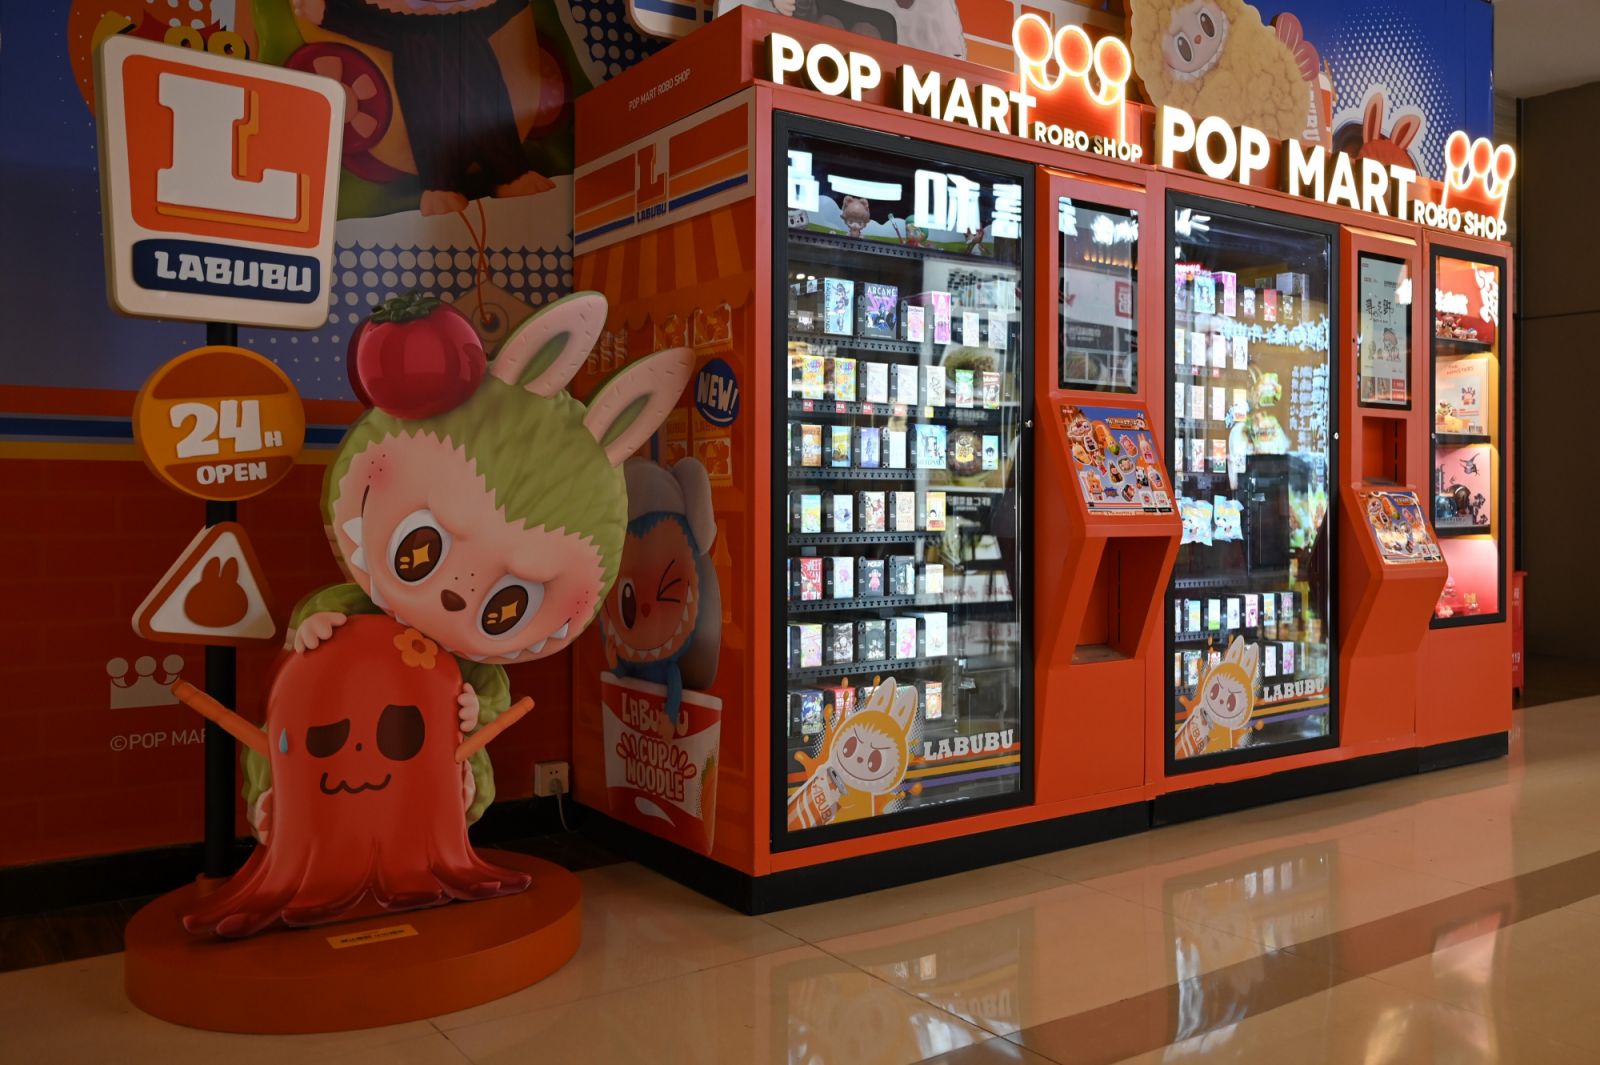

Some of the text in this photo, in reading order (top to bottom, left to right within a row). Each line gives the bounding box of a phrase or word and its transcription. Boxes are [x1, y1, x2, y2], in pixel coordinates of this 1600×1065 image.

[628, 68, 691, 112] POP MART ROBO SHOP
[771, 32, 1037, 139] POP MART
[157, 72, 300, 221] L
[1035, 126, 1144, 163] ROBO SHOP
[1162, 105, 1270, 185] POP
[1288, 138, 1417, 221] MART
[637, 202, 667, 223] LABUBU
[1413, 204, 1508, 241] ROBO SHOP
[155, 251, 312, 293] LABUBU
[697, 372, 739, 415] NEW!
[196, 462, 268, 486] OPEN
[1263, 678, 1325, 702] LABUBU
[621, 692, 689, 736] LABUU
[640, 737, 669, 768] CUP
[923, 729, 1014, 762] LABUBU
[626, 756, 684, 802] NOODLE
